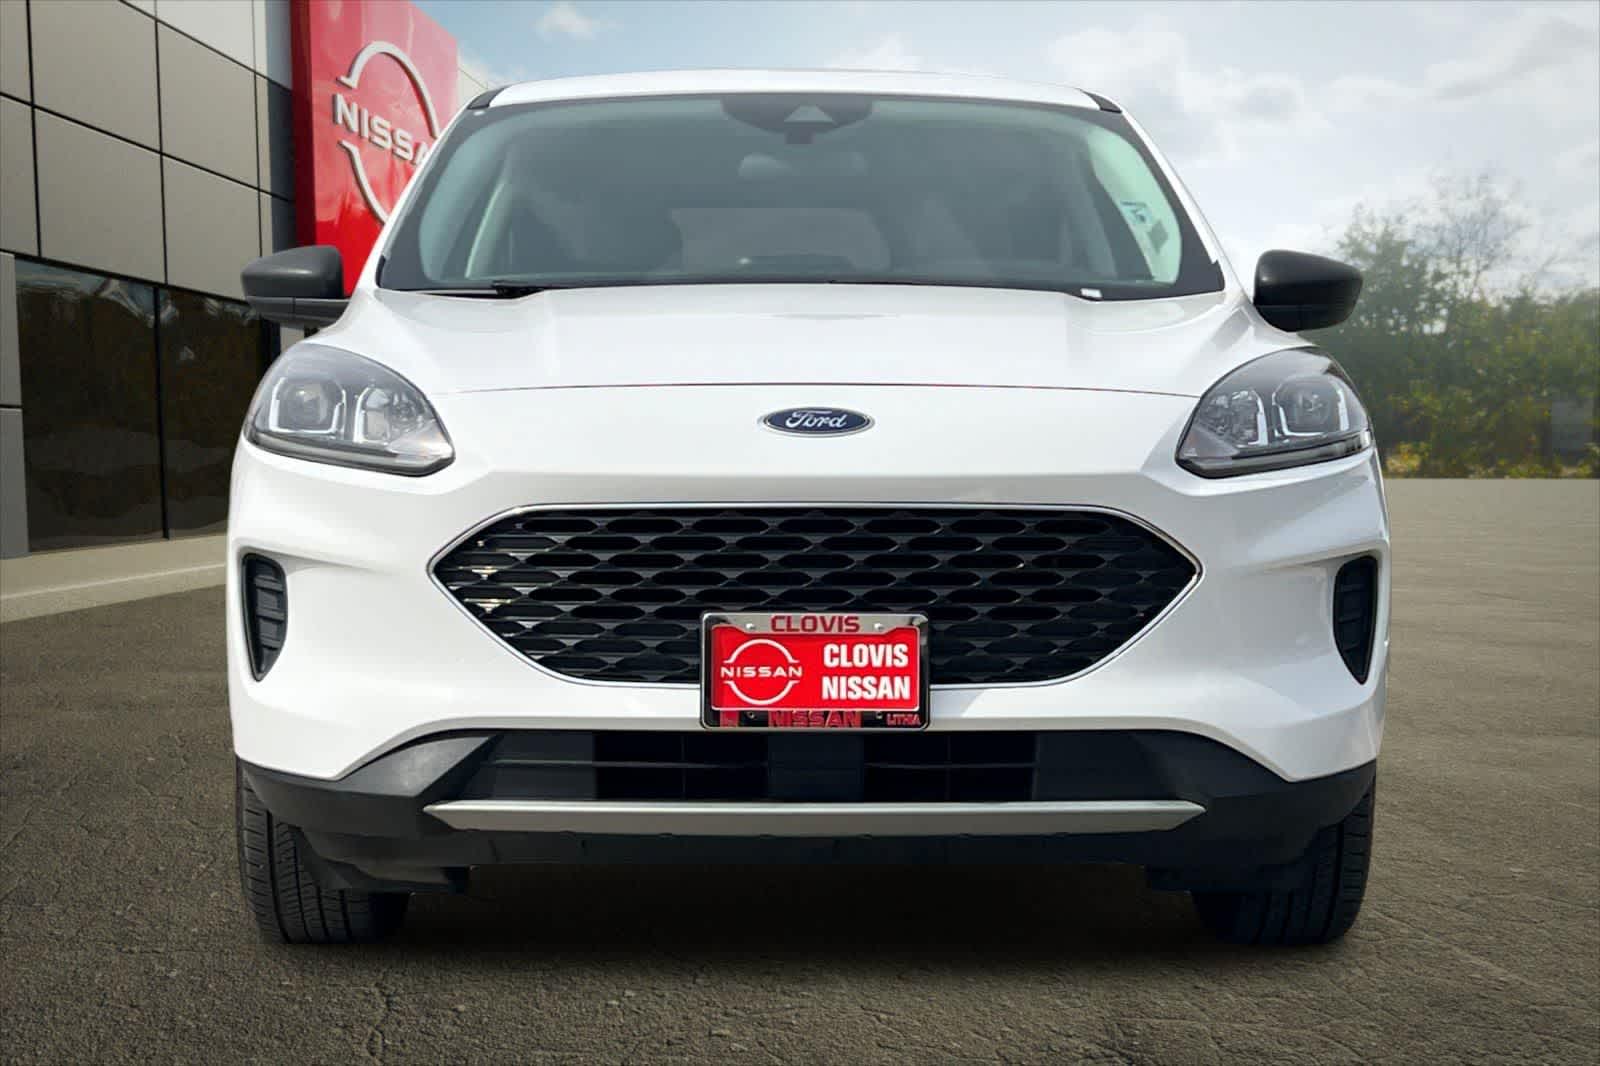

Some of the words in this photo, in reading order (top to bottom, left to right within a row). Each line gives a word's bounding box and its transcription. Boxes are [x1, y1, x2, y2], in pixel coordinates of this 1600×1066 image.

[786, 410, 847, 428] Ford
[771, 615, 860, 633] CLOVIS
[823, 644, 909, 668] CLOVIS
[720, 666, 803, 678] NISSAN
[821, 675, 911, 700] NISSAN
